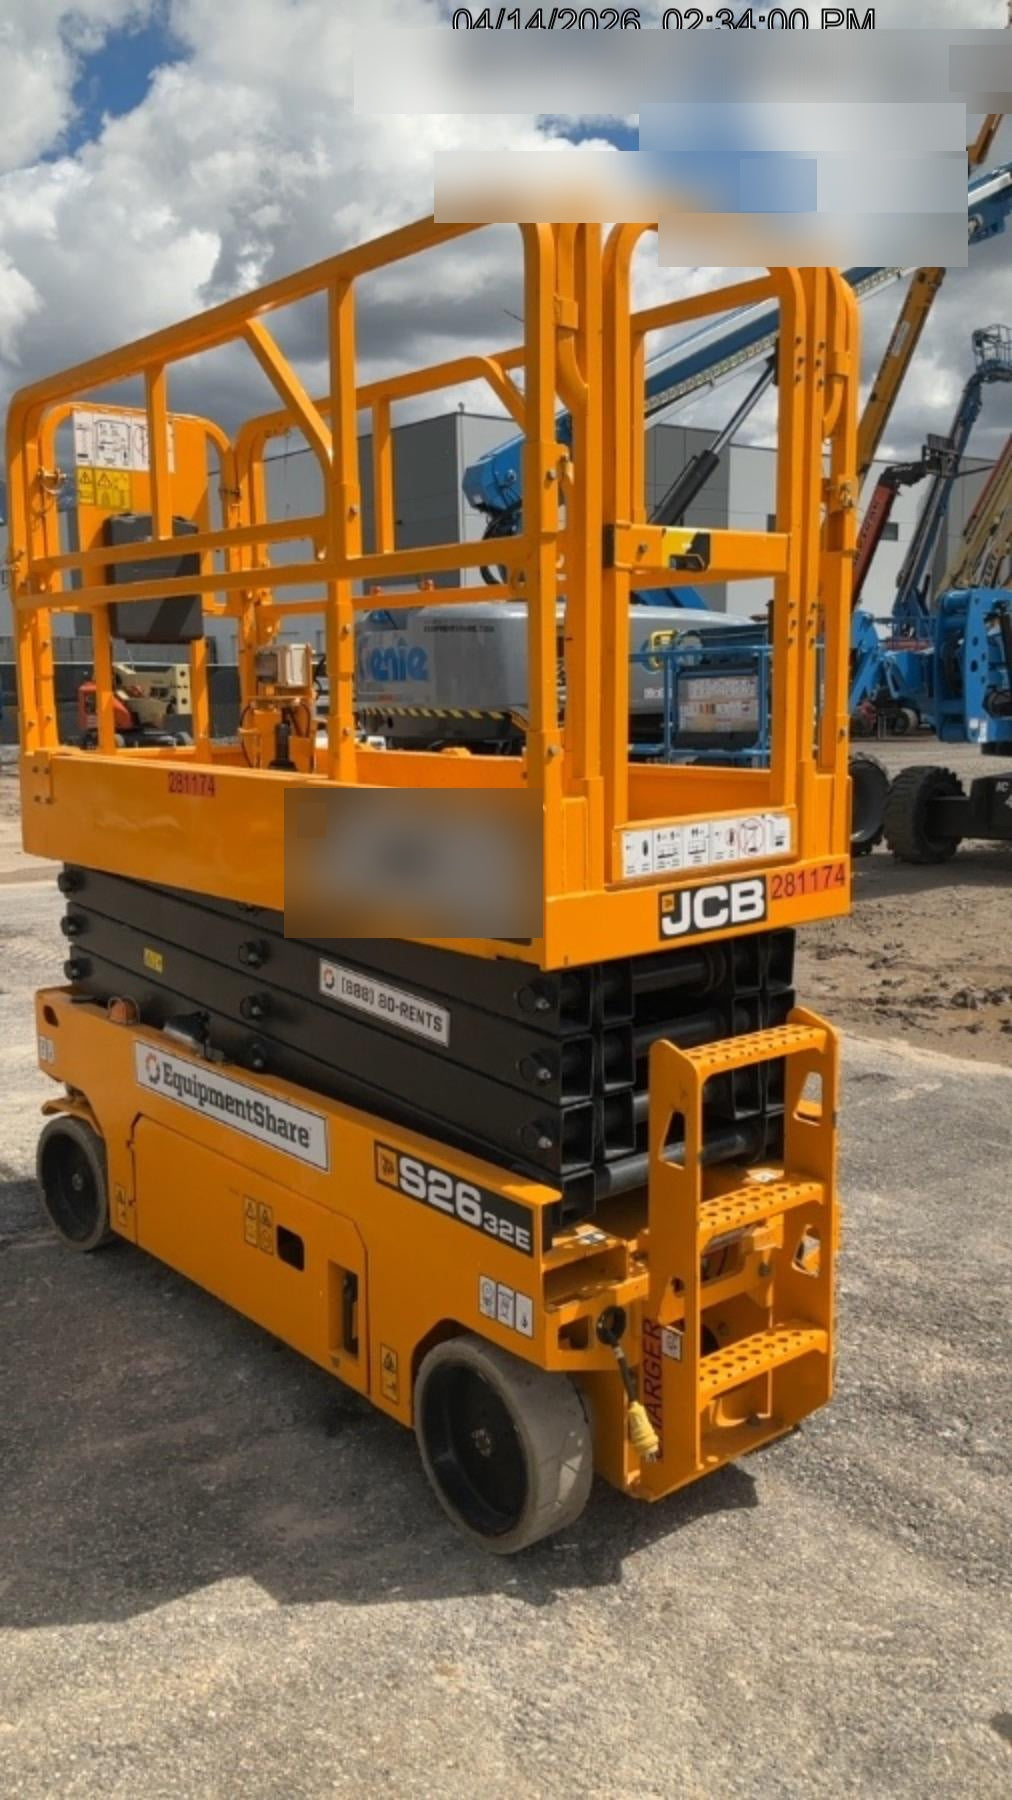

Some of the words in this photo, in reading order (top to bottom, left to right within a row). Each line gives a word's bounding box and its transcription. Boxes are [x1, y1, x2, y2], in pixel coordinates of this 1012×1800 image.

[167, 770, 216, 797] 281174
[771, 863, 846, 899] 281174
[661, 879, 766, 936] JCB
[378, 993, 443, 1032] 80-RENTS
[162, 1060, 311, 1149] EquipmentShare
